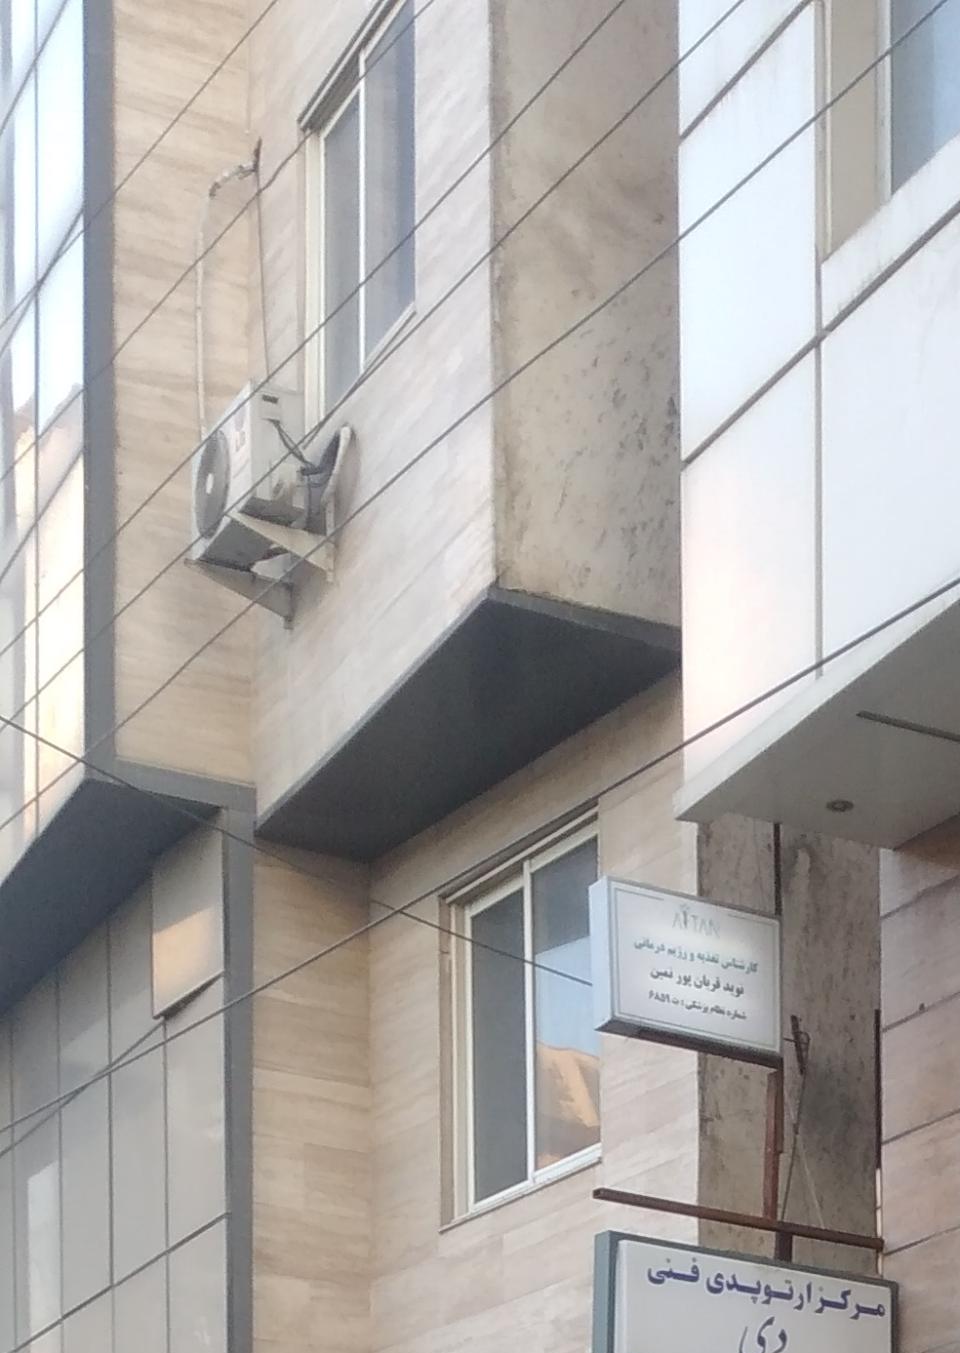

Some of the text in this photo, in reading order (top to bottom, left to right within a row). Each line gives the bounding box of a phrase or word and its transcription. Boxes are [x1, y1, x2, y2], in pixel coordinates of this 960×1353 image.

[633, 938, 665, 954] درمانی
[689, 952, 695, 962] و
[723, 981, 745, 998] نوید
[647, 1257, 886, 1319] مرکز ارتوپدی فنی
